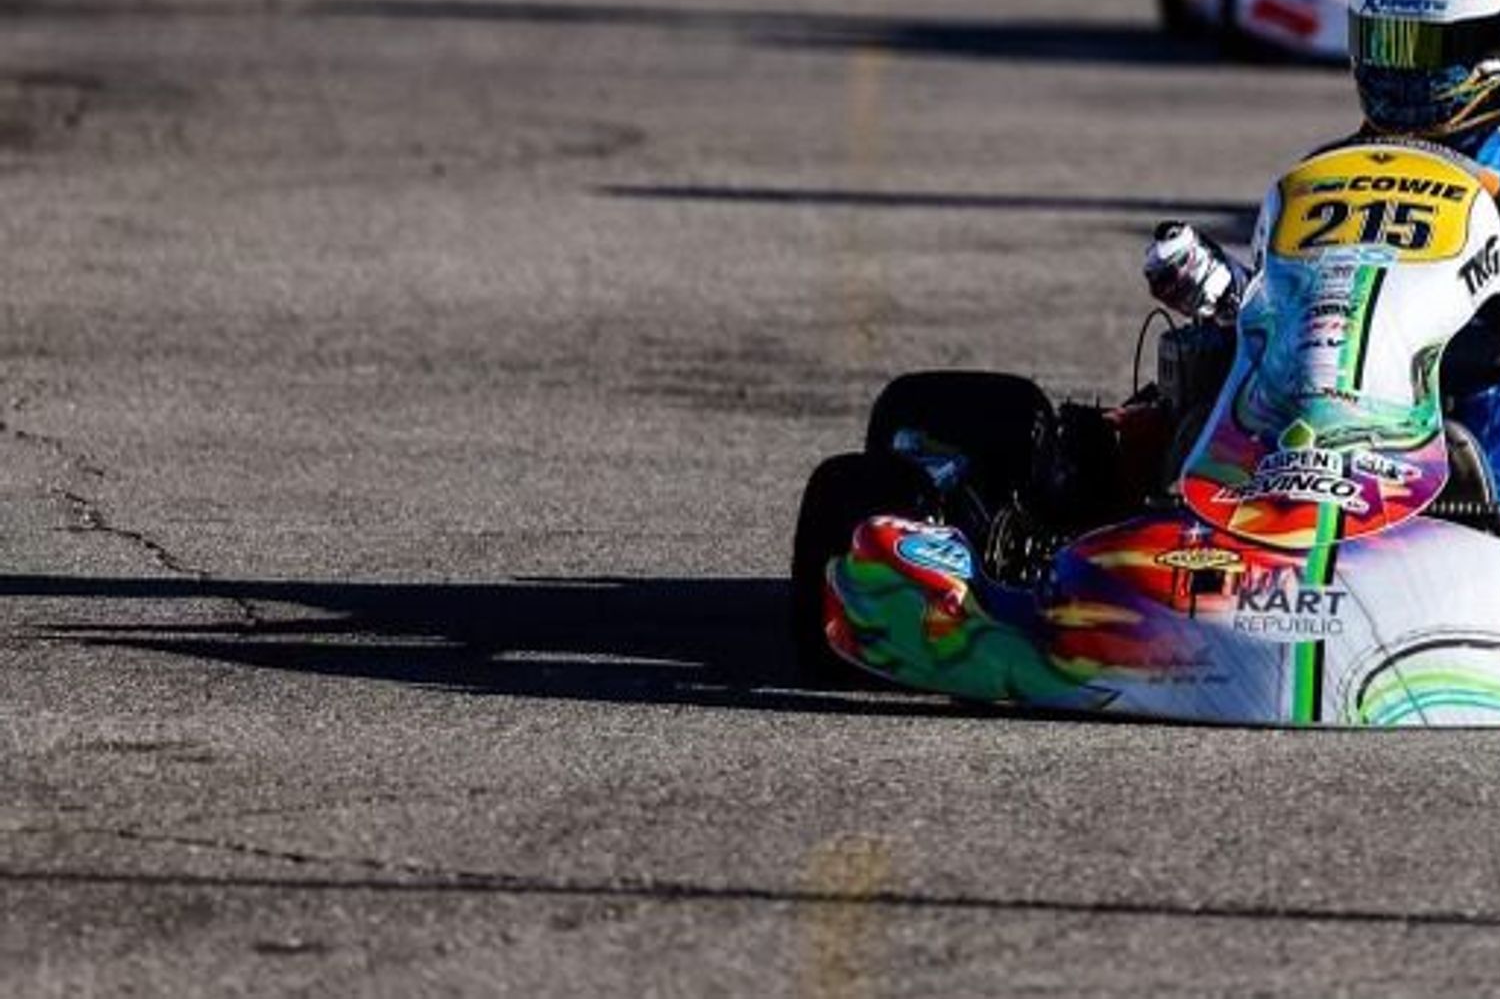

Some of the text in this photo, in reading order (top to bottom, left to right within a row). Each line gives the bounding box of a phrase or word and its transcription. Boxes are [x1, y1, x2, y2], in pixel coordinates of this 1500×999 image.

[1349, 176, 1468, 200] COWIE
[1299, 201, 1434, 250] 215
[1458, 236, 1500, 295] TKG
[1237, 591, 1346, 616] KART
